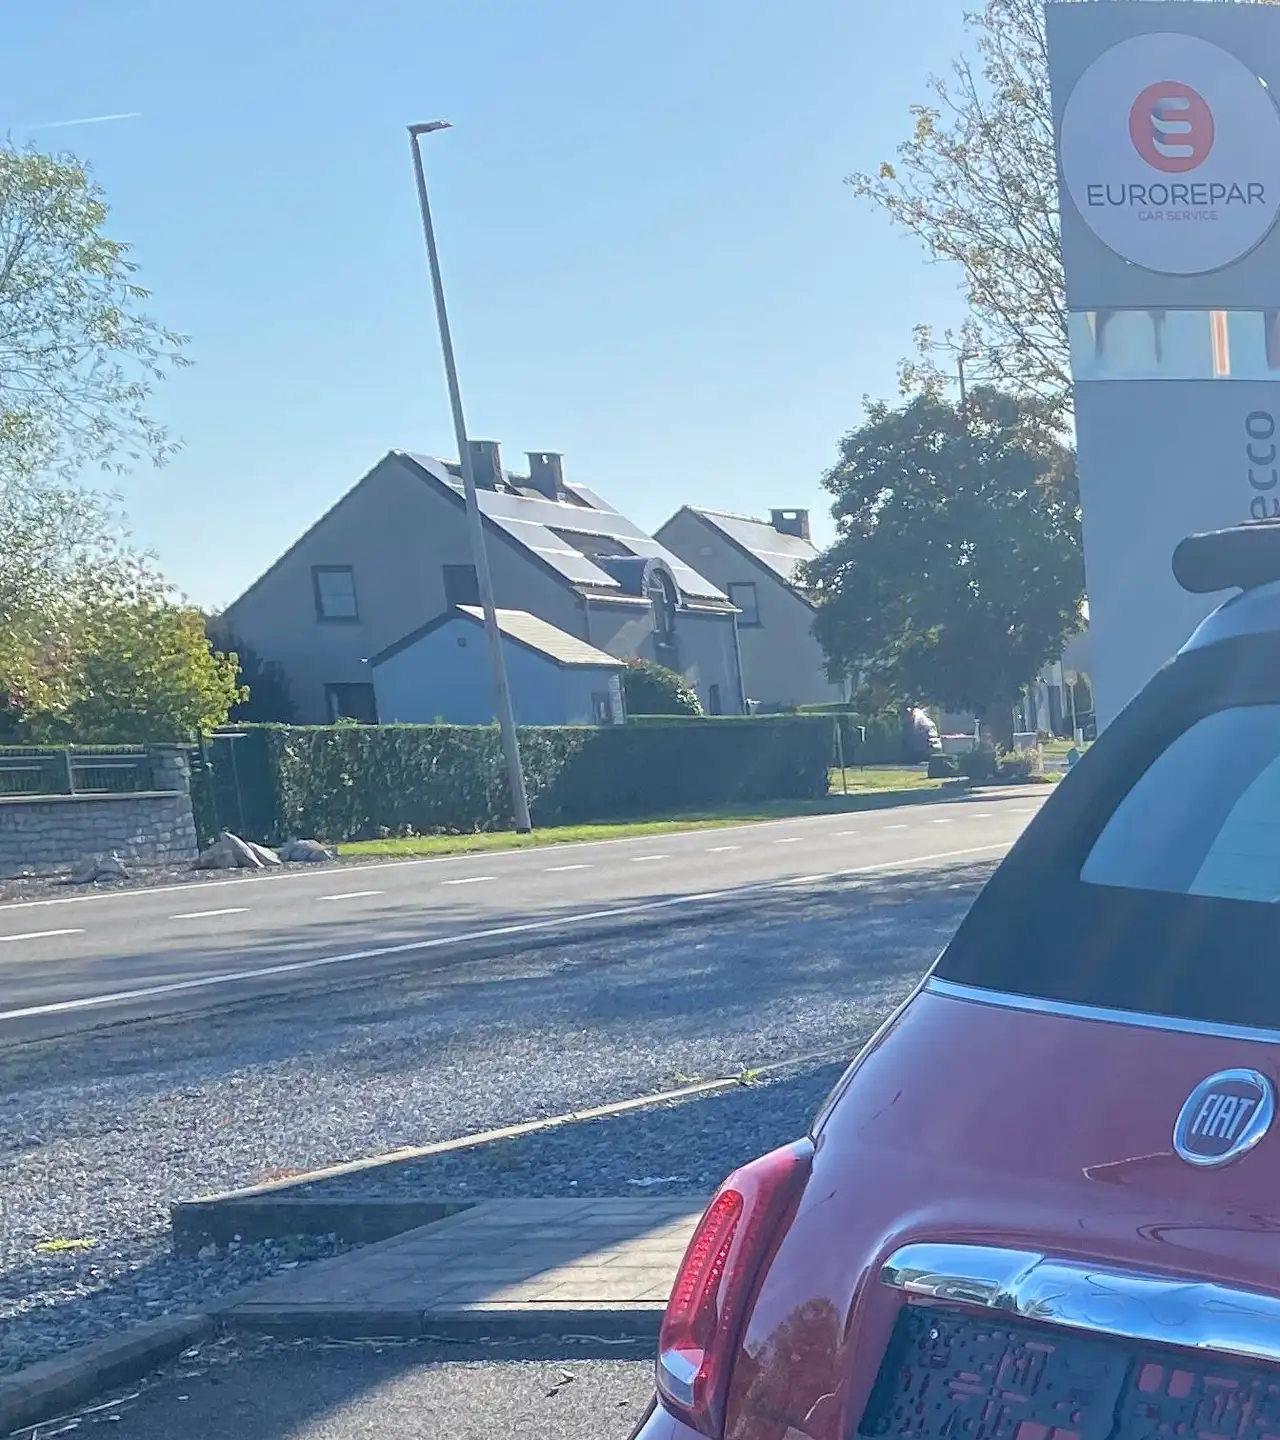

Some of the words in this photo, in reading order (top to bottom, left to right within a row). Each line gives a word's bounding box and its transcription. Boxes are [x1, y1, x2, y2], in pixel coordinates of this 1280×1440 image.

[1086, 182, 1266, 207] EUROREPAR
[1138, 210, 1164, 222] CAR
[1167, 209, 1218, 222] SERVICE
[1191, 1093, 1257, 1140] FIAT
